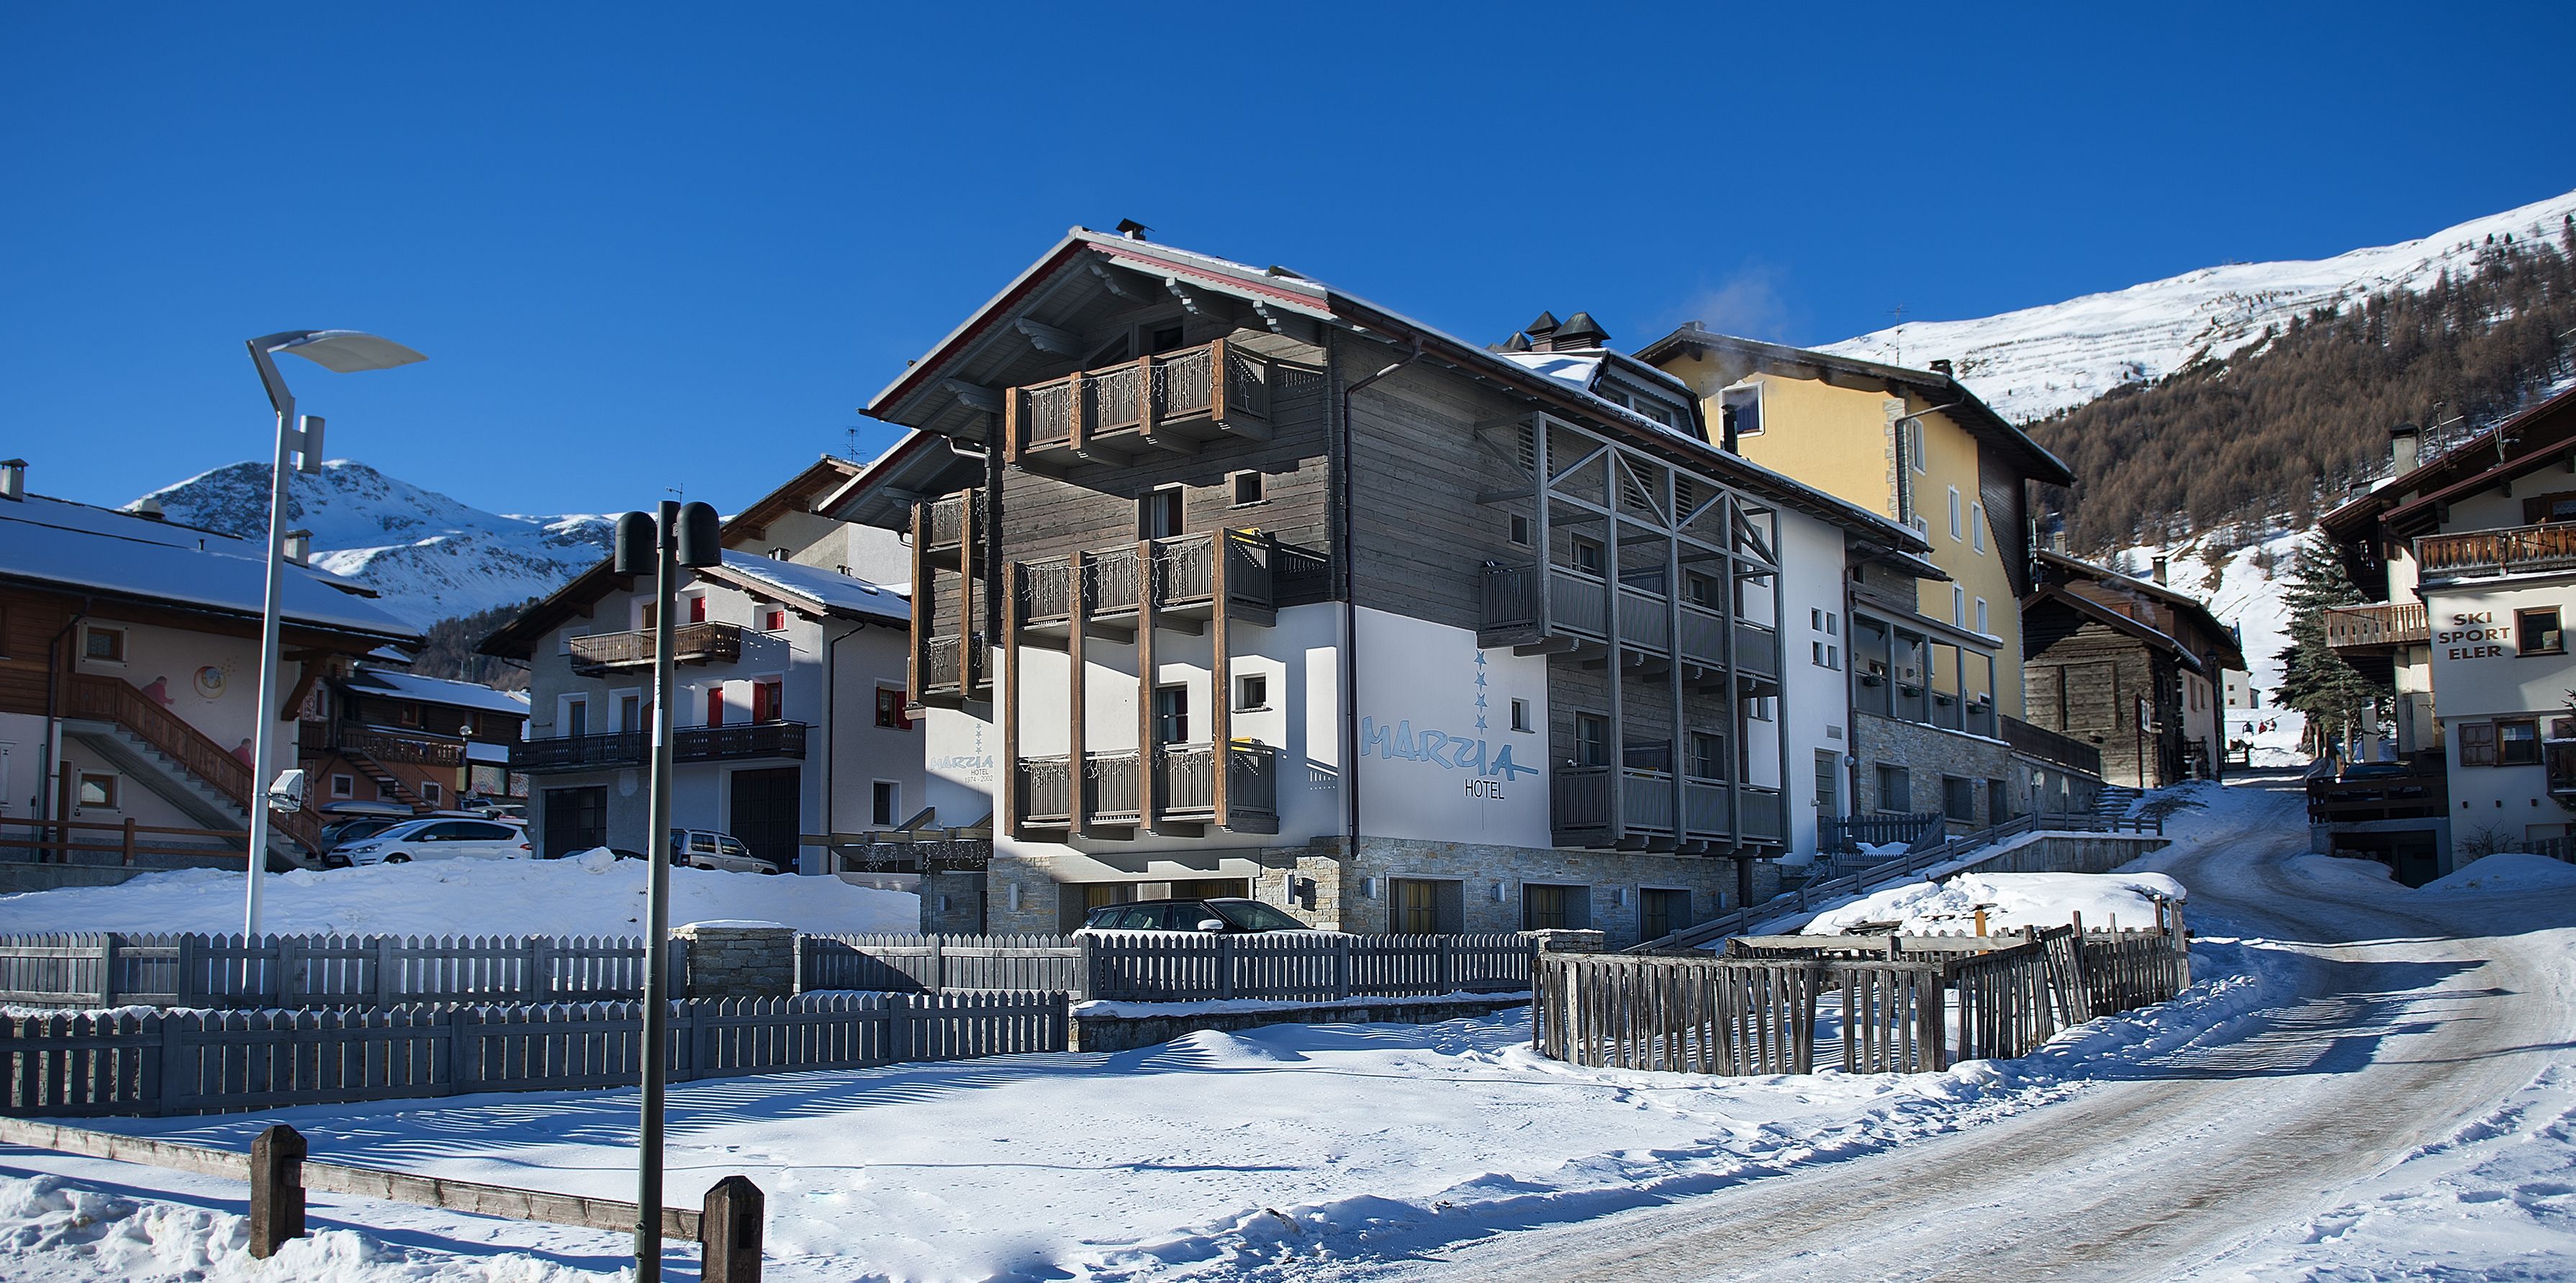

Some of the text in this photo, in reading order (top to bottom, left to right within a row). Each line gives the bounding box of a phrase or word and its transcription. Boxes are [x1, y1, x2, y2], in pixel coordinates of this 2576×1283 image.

[2453, 612, 2492, 625] SKI
[2438, 627, 2511, 643] SPORT
[2449, 645, 2503, 660] ELER
[1361, 716, 1539, 781] MARZIA
[930, 755, 993, 771] MARZIA
[1465, 779, 1505, 800] HOTEL
